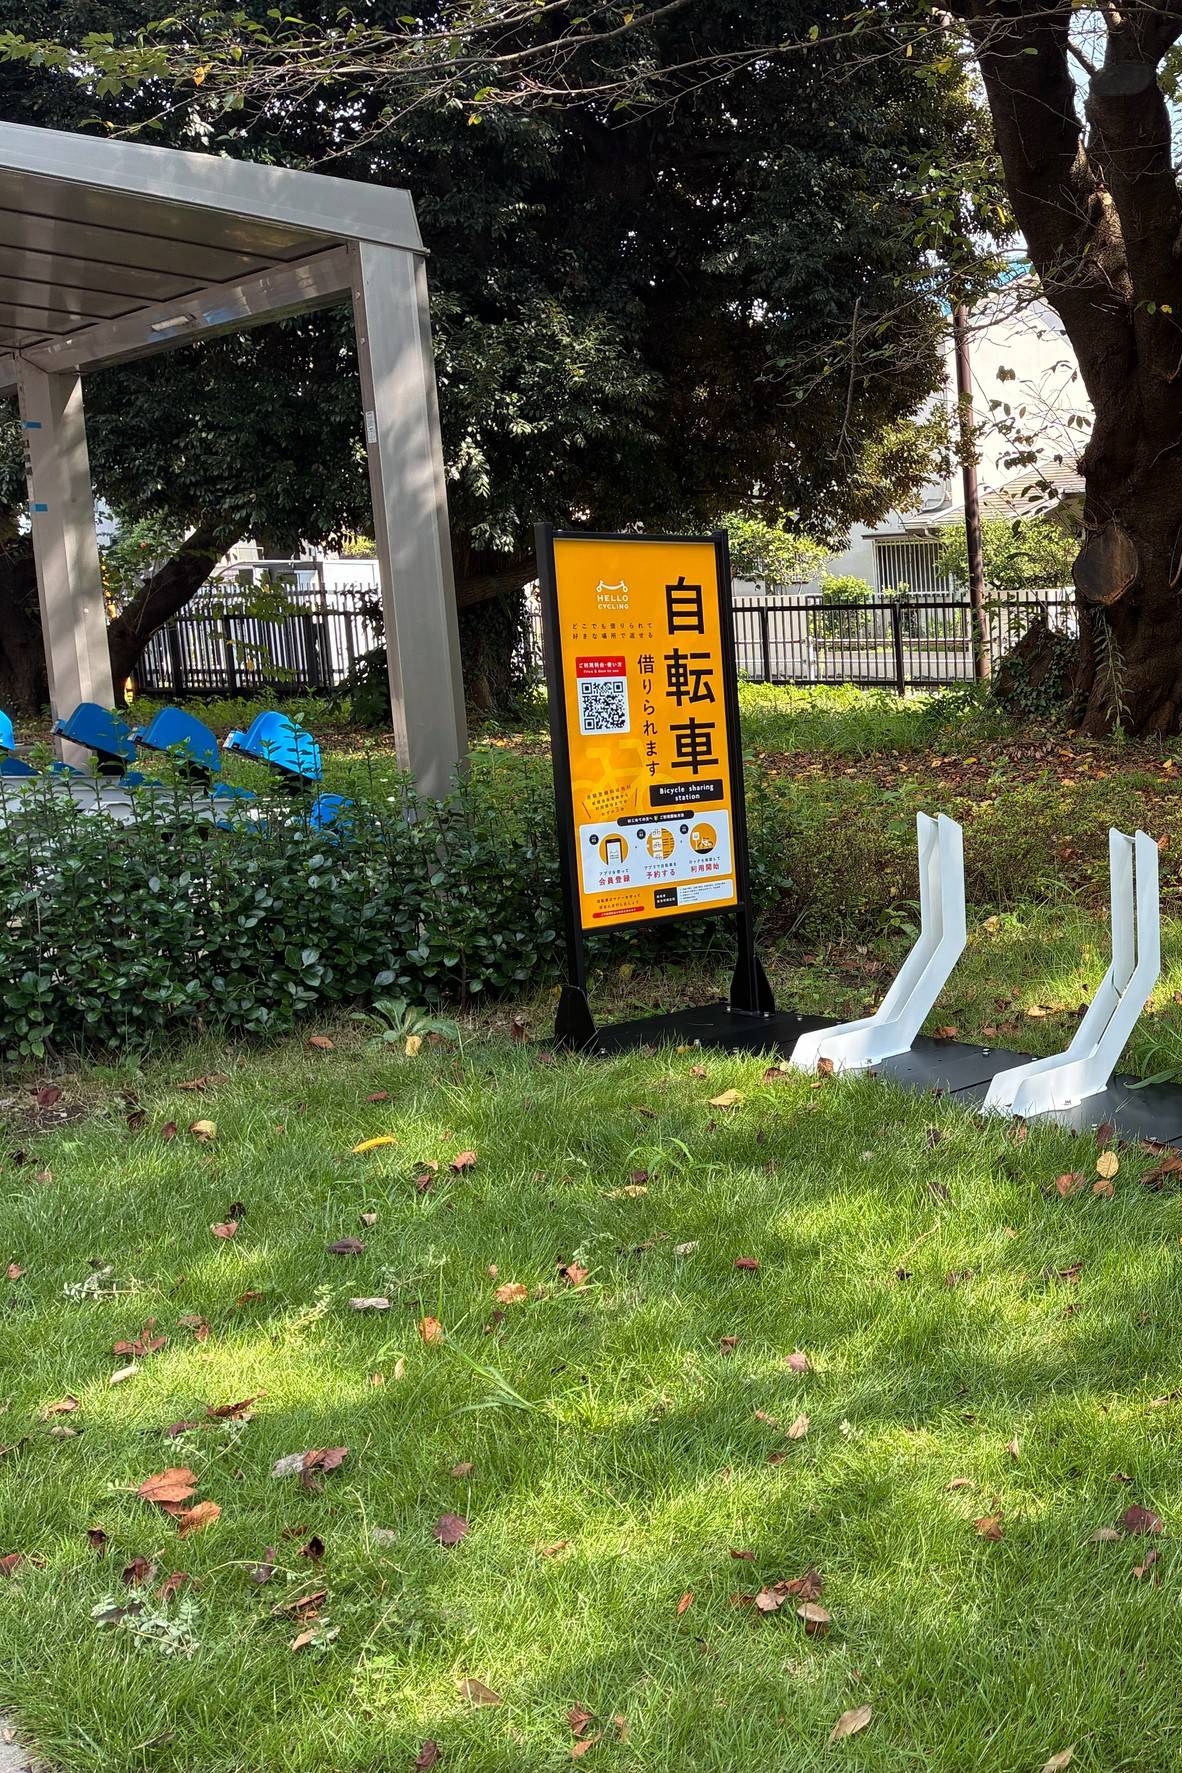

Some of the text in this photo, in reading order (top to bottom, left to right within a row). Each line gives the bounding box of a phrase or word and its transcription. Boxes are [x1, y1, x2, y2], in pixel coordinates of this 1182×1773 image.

[597, 594, 628, 602] HELLO
[664, 576, 719, 775] 自転車
[637, 654, 660, 777] 借りられます
[659, 784, 714, 796] Bicycle sharing
[674, 793, 701, 801] station
[646, 868, 676, 880] 予約する
